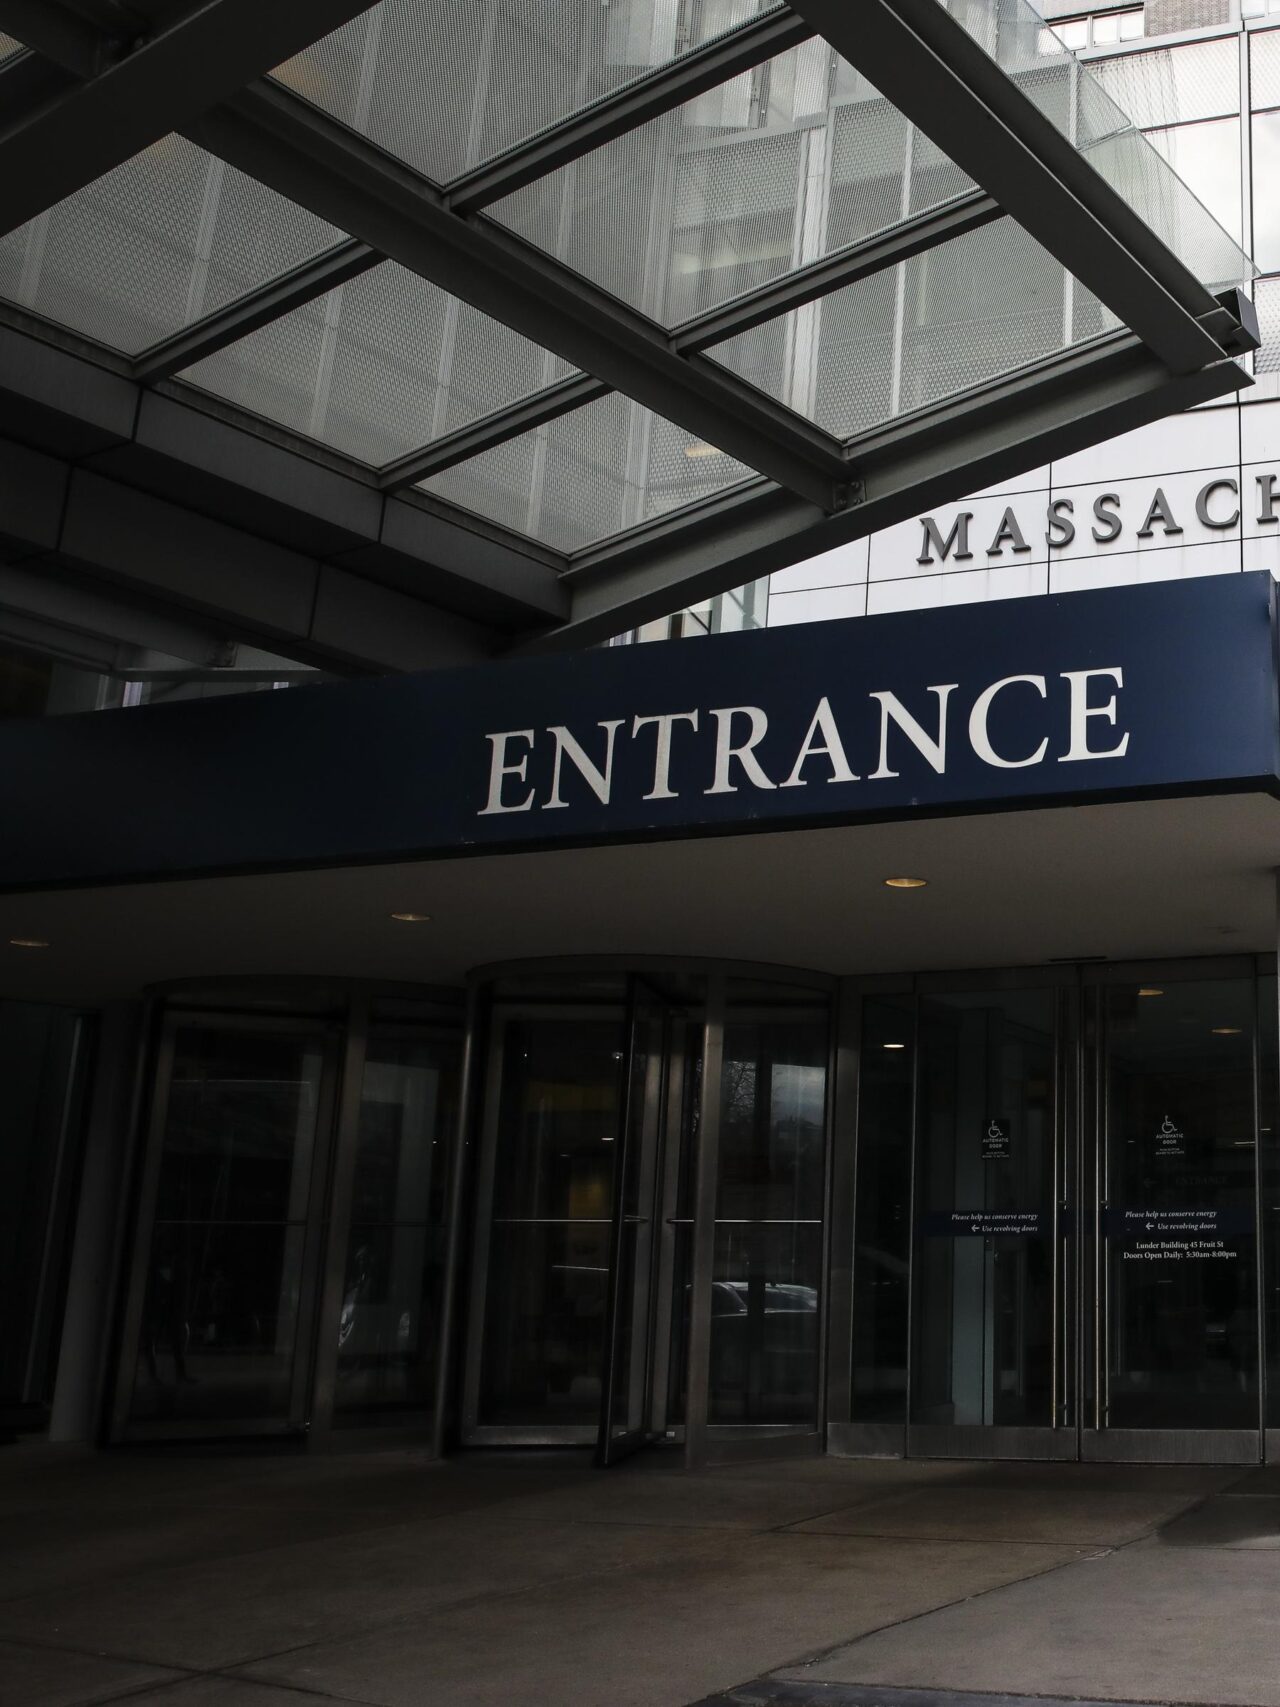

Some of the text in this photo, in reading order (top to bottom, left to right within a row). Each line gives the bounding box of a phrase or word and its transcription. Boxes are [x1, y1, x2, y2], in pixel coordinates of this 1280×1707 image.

[477, 666, 1131, 816] ENTRANCE
[970, 1213, 983, 1221] help
[1017, 1213, 1038, 1221] energy
[1125, 1211, 1144, 1219] Please
[1145, 1210, 1159, 1219] help
[1195, 1210, 1217, 1218] energy
[993, 1225, 1021, 1233] revolving
[1021, 1224, 1038, 1232] doors
[1169, 1222, 1198, 1231] revolving
[1160, 1241, 1189, 1250] Building
[1216, 1240, 1224, 1248] St
[1144, 1252, 1162, 1260] Open
[1163, 1251, 1183, 1260] Daily:
[1185, 1251, 1237, 1259] 5:30am-8:00pm
